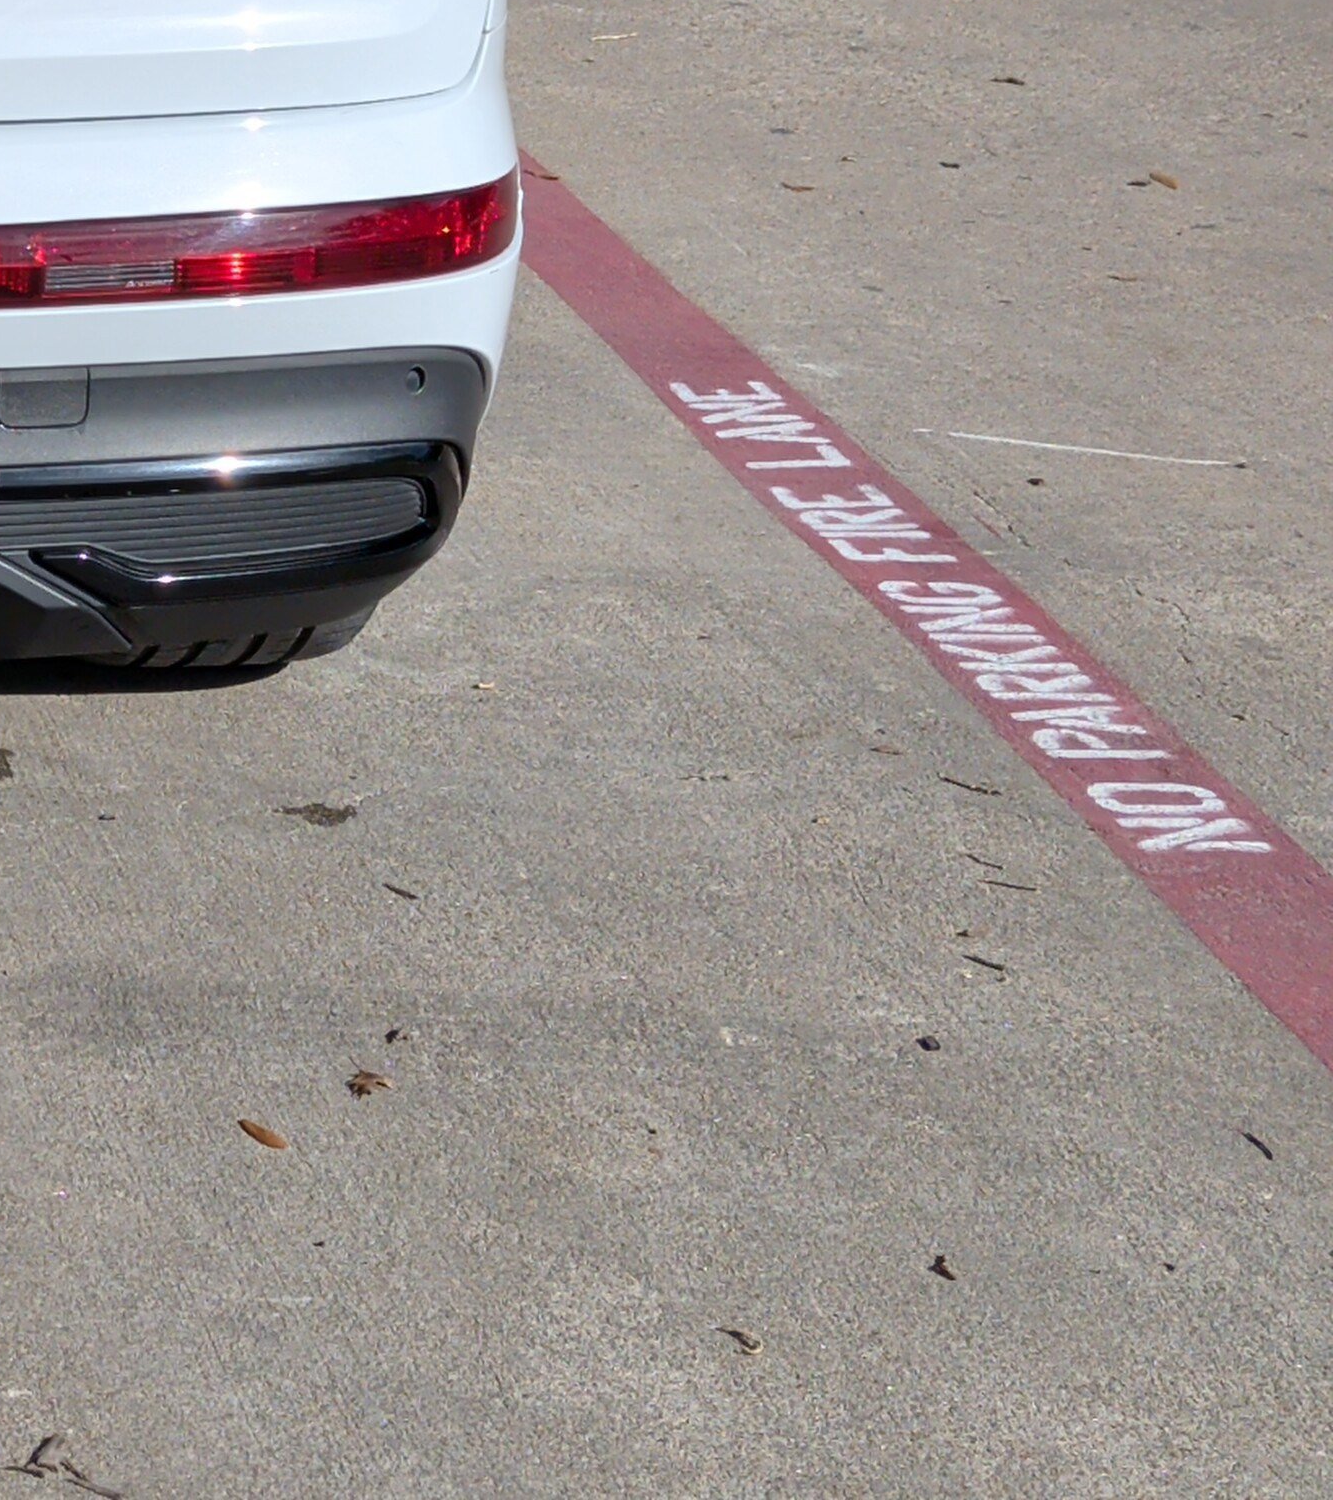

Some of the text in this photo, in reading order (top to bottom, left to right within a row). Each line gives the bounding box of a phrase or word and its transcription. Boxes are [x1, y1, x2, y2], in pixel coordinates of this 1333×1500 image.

[669, 381, 1273, 853] NO PARKING FIRE LANE
